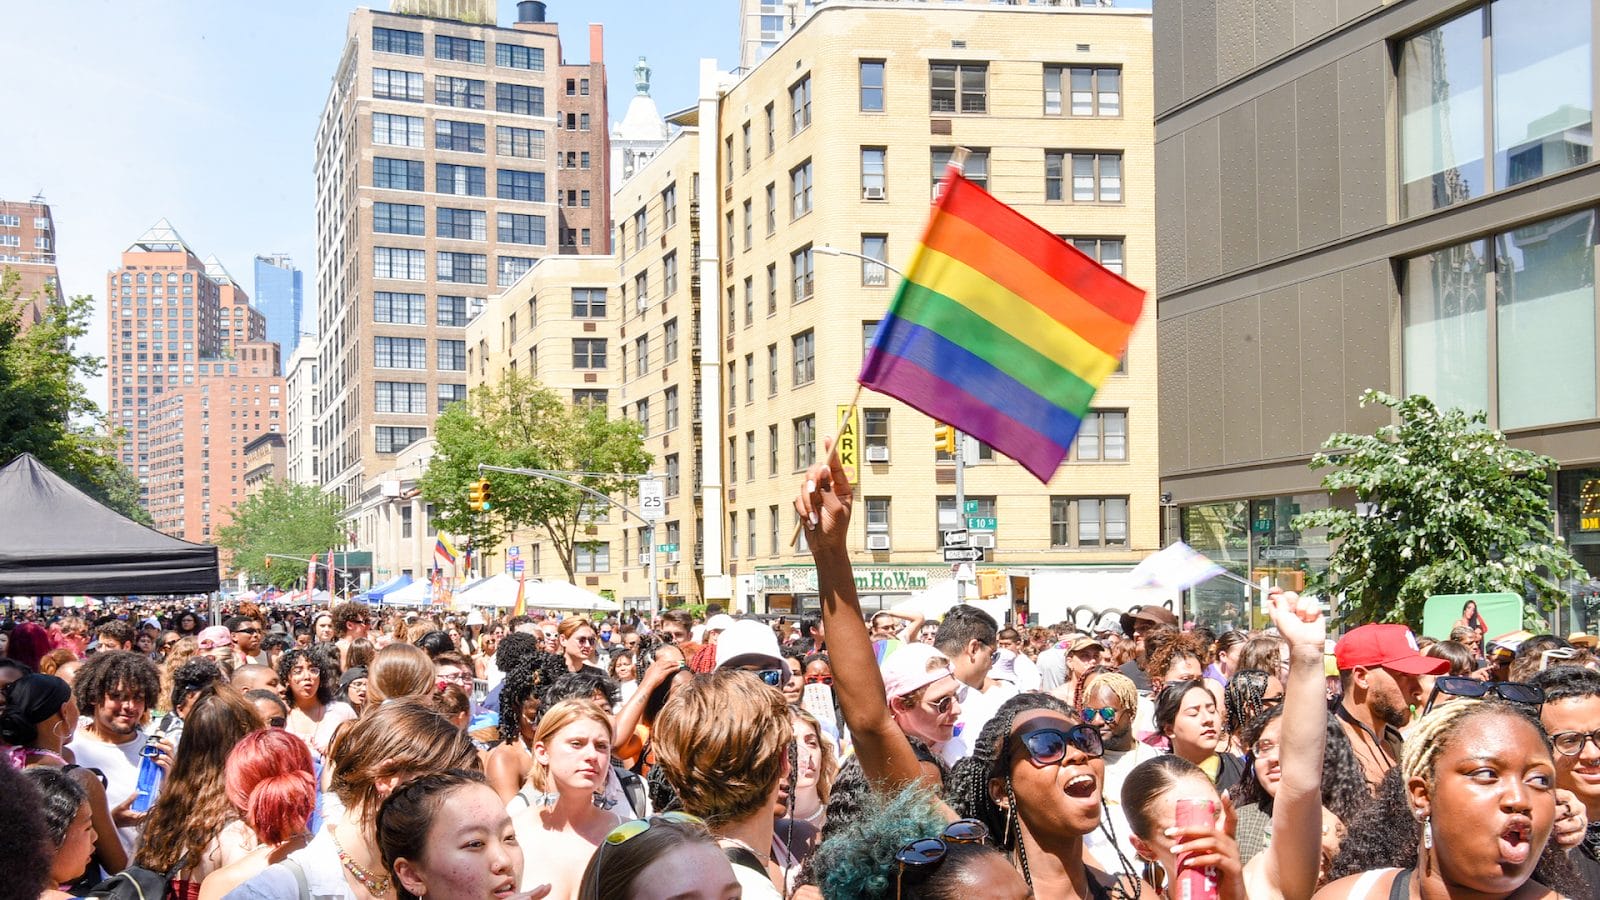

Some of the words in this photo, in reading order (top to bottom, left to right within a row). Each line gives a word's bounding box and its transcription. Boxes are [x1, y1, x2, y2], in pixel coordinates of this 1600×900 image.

[644, 496, 661, 507] 25
[969, 518, 974, 528] E
[977, 518, 986, 528] 10
